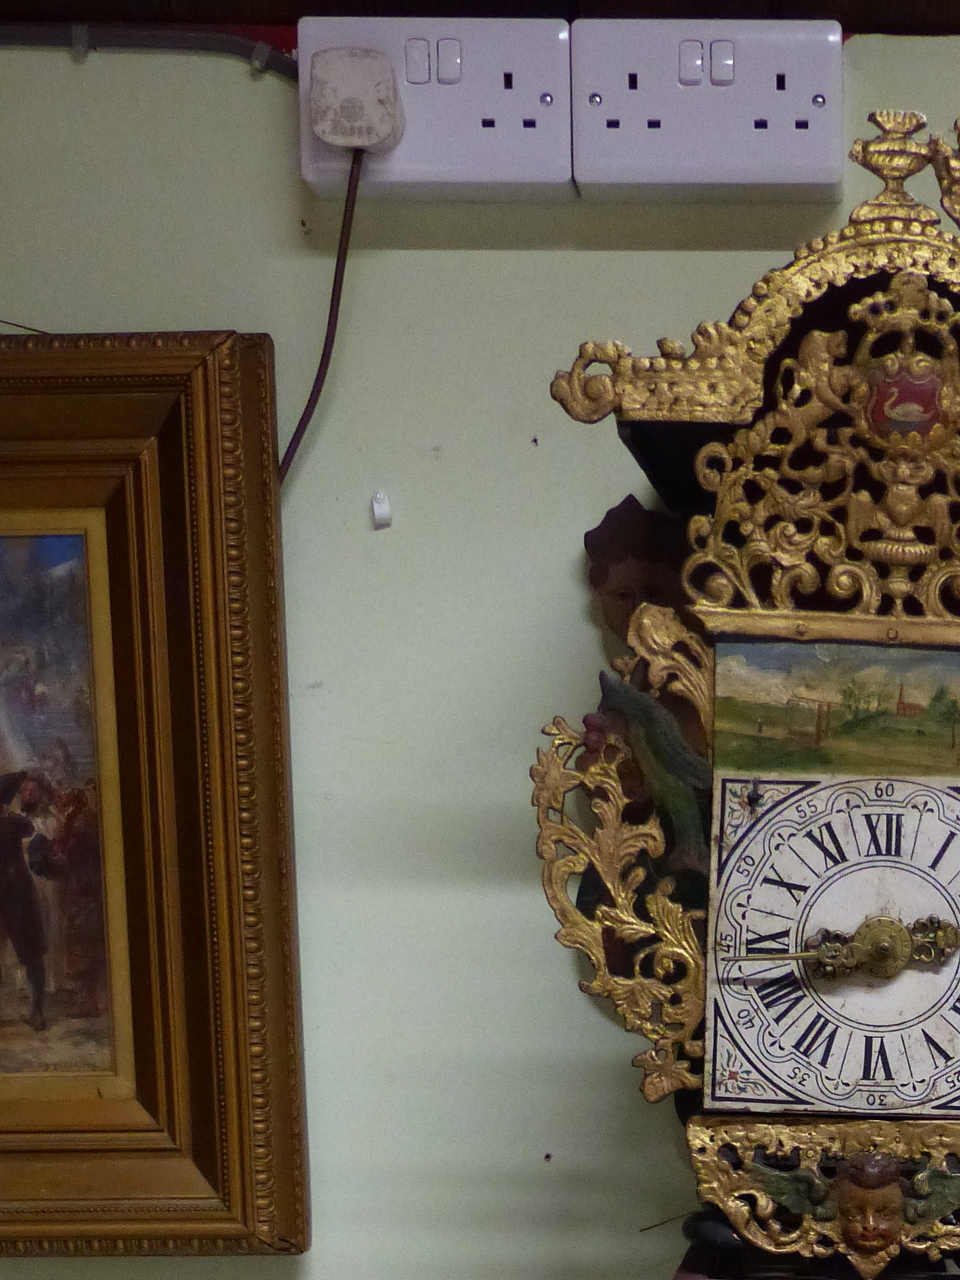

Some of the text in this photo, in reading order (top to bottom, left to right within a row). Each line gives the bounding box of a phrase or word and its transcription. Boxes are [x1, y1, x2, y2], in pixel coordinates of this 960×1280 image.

[874, 783, 894, 797] 60
[796, 802, 818, 818] 55
[803, 822, 848, 872] XI
[862, 813, 904, 857] XII
[929, 830, 957, 872] I
[736, 855, 757, 877] 50
[761, 866, 810, 906] X
[720, 932, 735, 952] 45
[746, 929, 790, 956] IX
[756, 969, 810, 1024] VIII
[737, 1008, 755, 1030] 40
[792, 1012, 842, 1069] VII
[921, 1028, 955, 1069] V
[861, 1036, 894, 1081] VI
[786, 1066, 811, 1085] 35
[866, 1094, 887, 1106] 30
